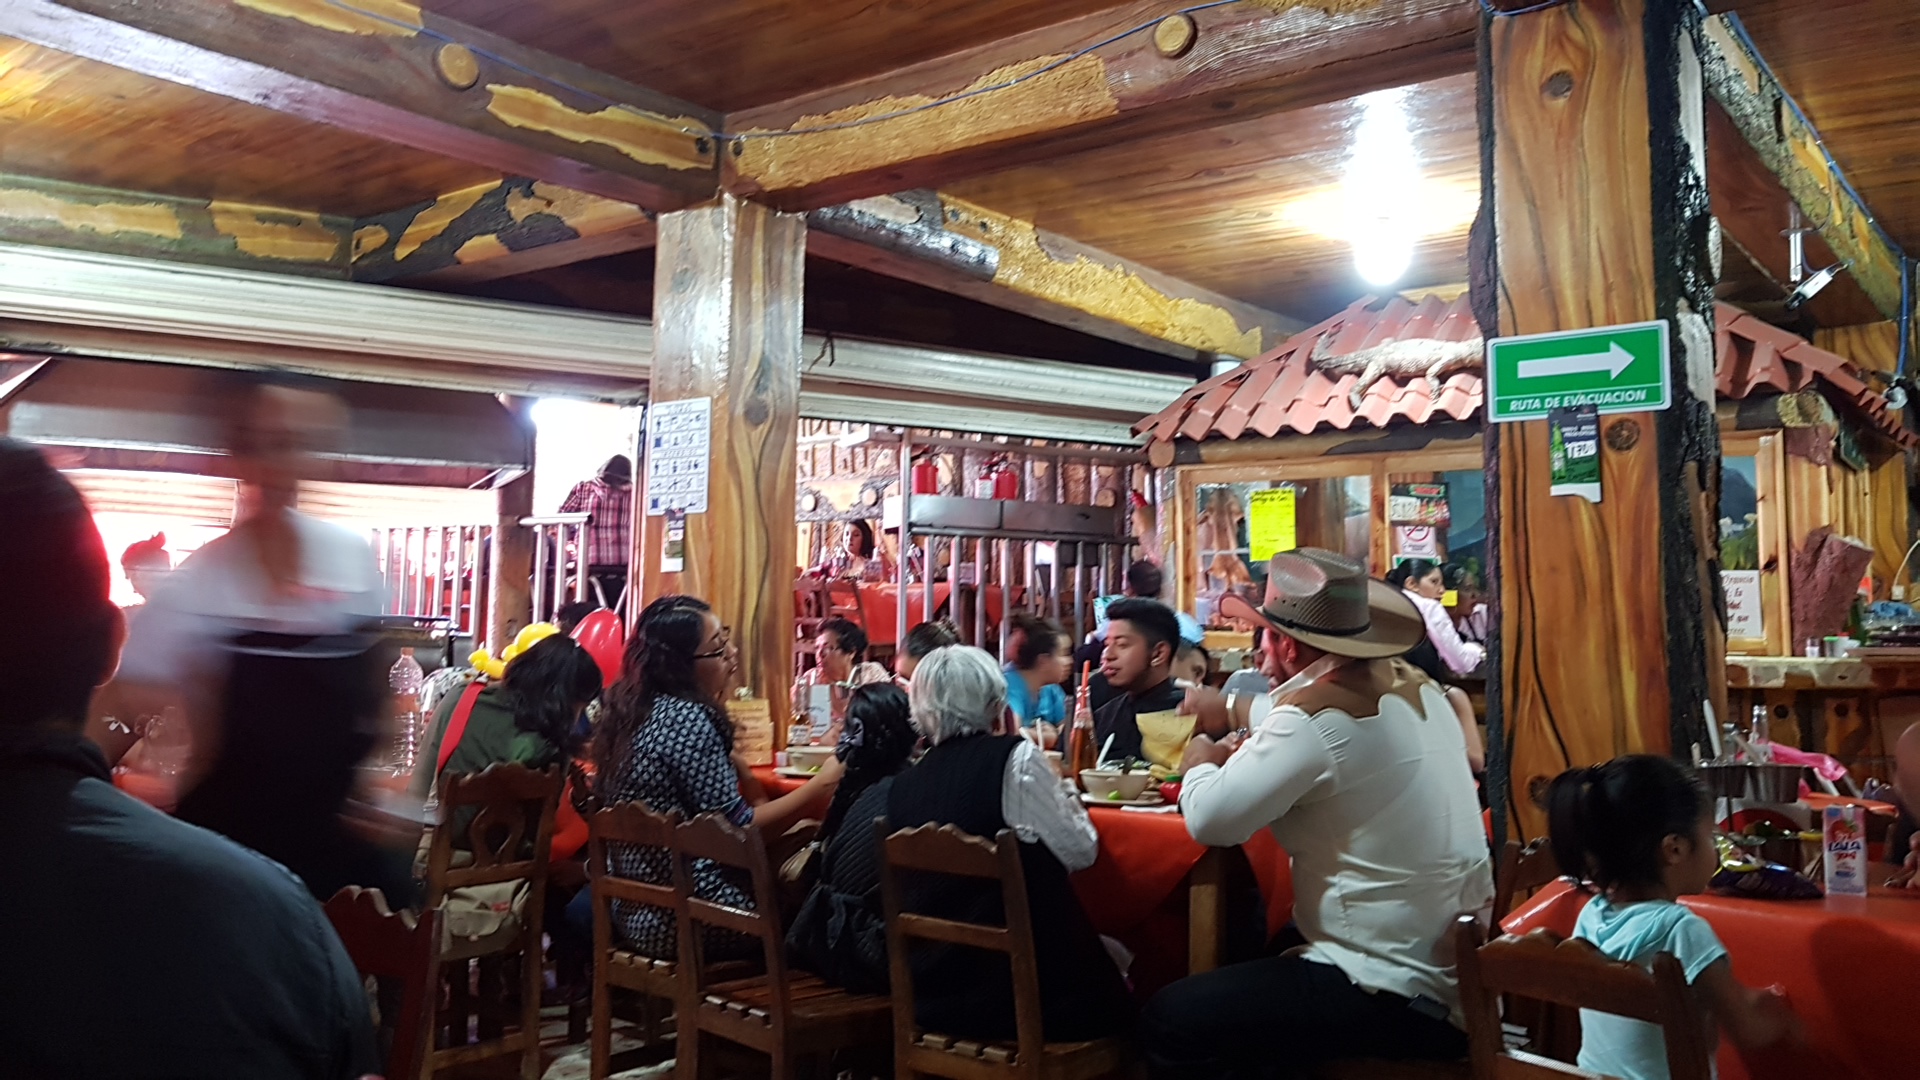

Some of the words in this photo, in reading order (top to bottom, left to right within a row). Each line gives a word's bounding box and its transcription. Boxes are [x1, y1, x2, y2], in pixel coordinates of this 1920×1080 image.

[1509, 398, 1541, 411] RUTA
[1544, 396, 1560, 408] DE
[1562, 389, 1647, 407] EVACUACION
